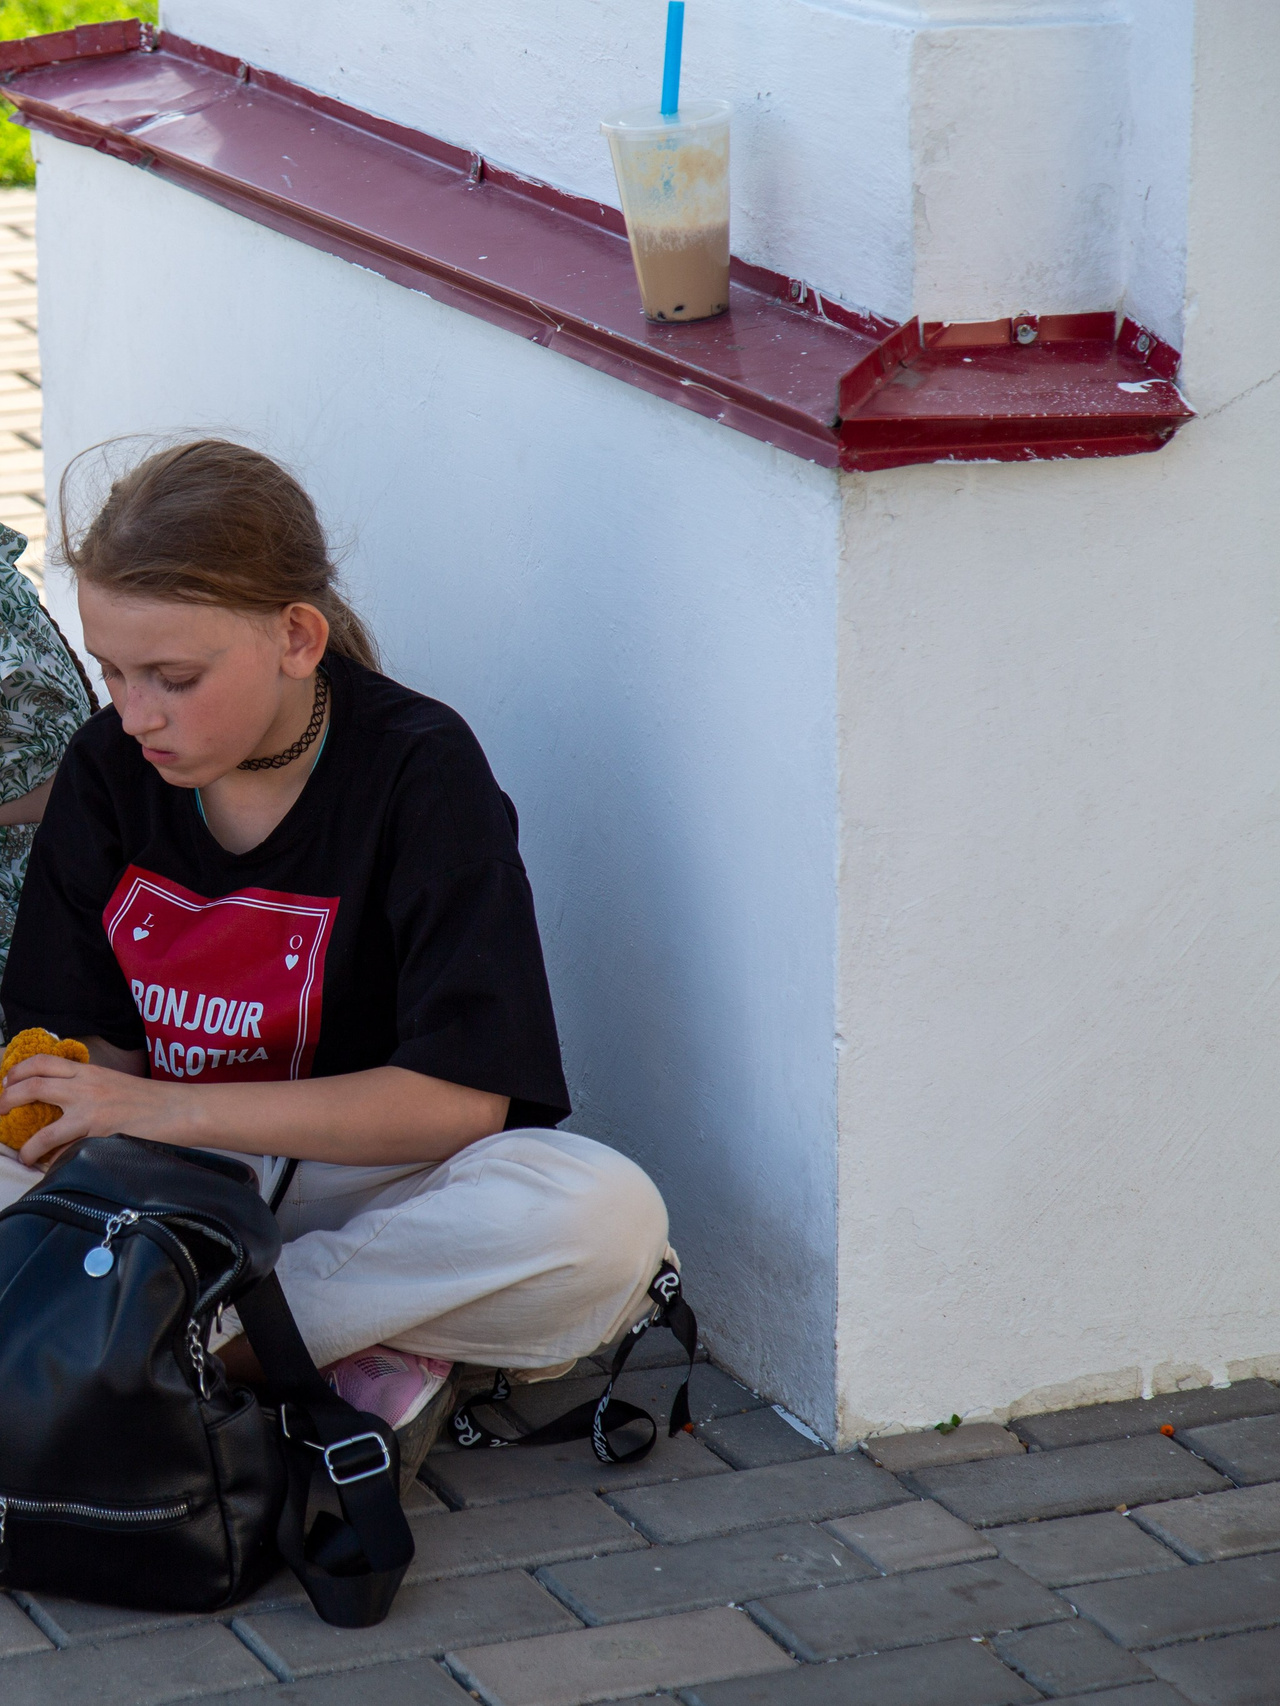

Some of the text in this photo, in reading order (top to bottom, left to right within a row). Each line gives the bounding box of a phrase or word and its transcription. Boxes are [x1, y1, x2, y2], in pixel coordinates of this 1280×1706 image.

[142, 912, 156, 928] L
[289, 934, 303, 950] O
[131, 978, 264, 1039] BONJOUR
[146, 1035, 269, 1078] АСОТКА
